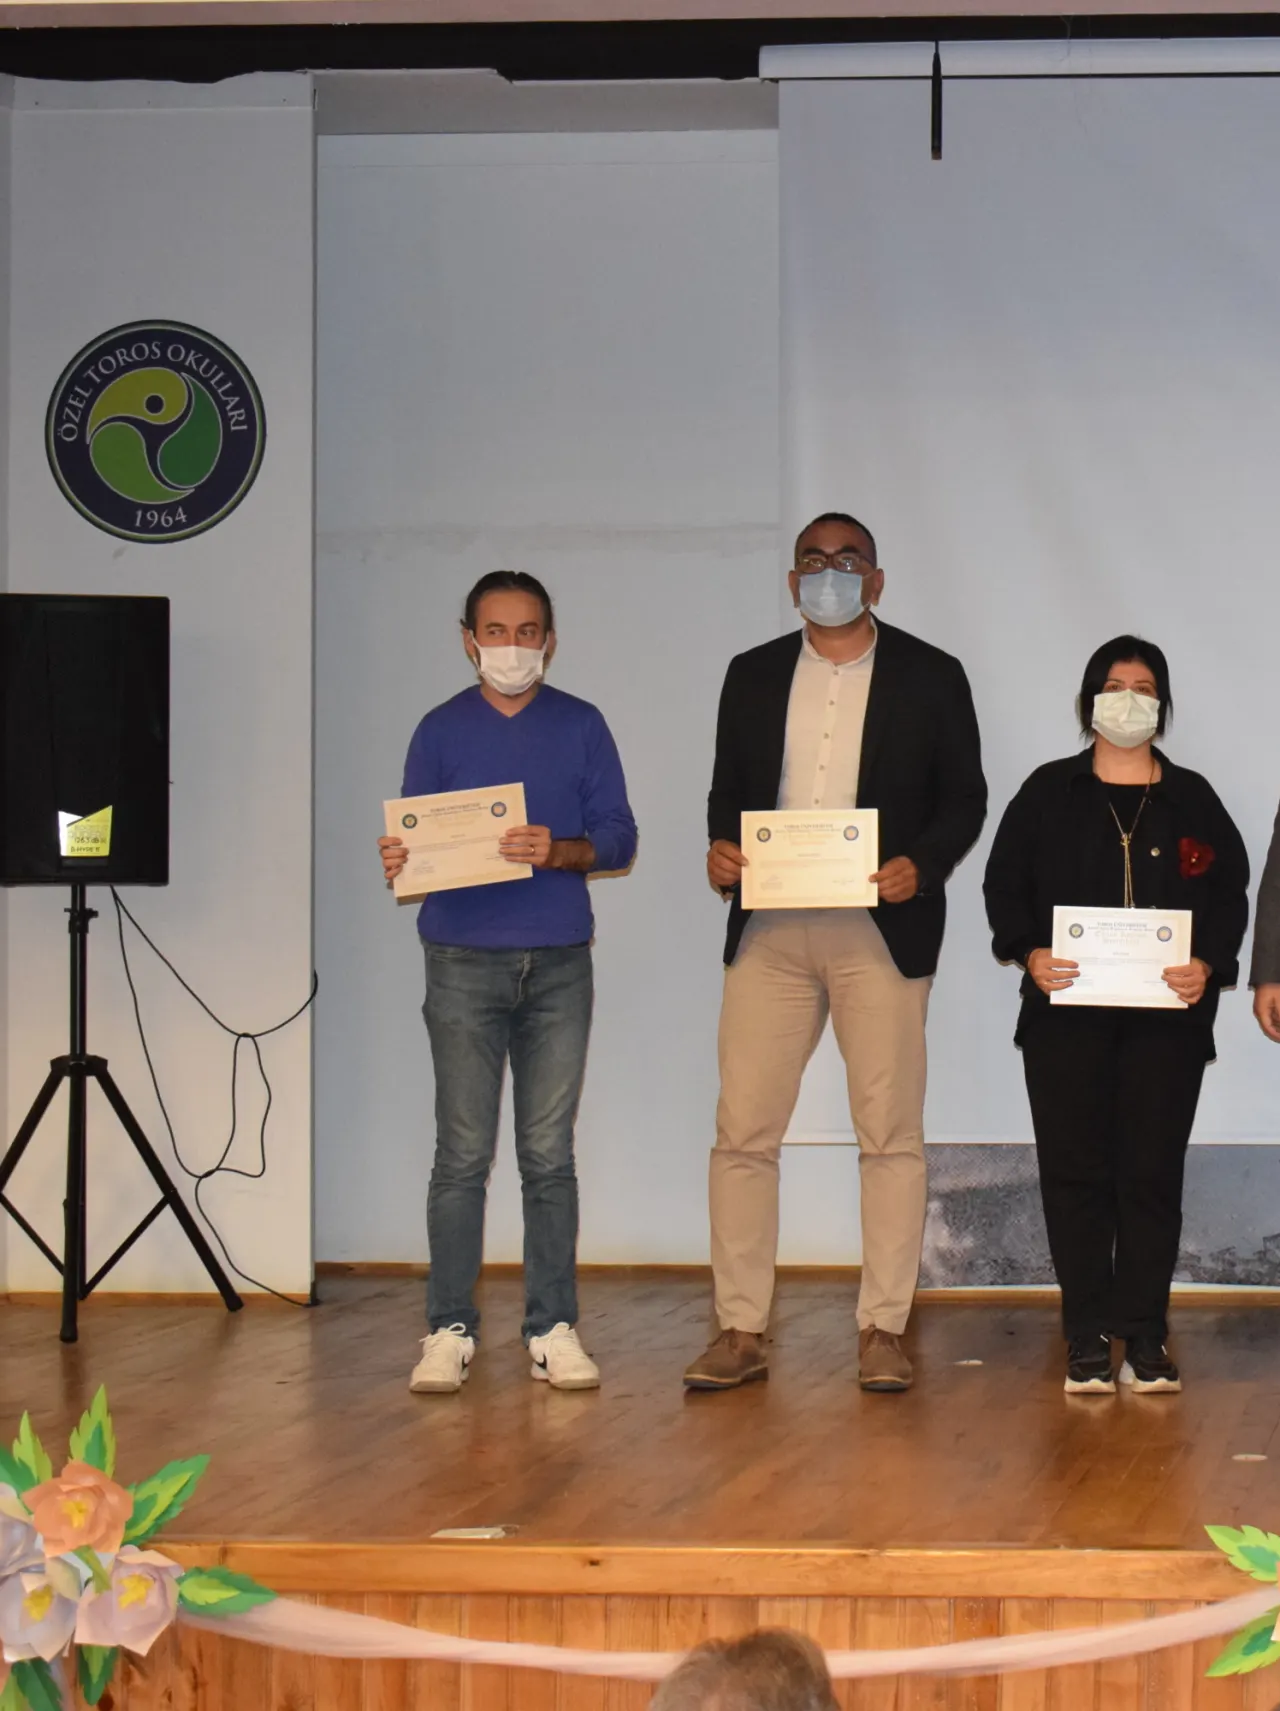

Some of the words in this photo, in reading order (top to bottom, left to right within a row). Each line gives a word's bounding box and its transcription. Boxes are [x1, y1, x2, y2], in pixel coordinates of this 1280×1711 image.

[57, 383, 93, 442] ÖZEL
[83, 341, 161, 384] TOROS
[167, 344, 248, 432] OKULLARI
[134, 506, 188, 528] 1964
